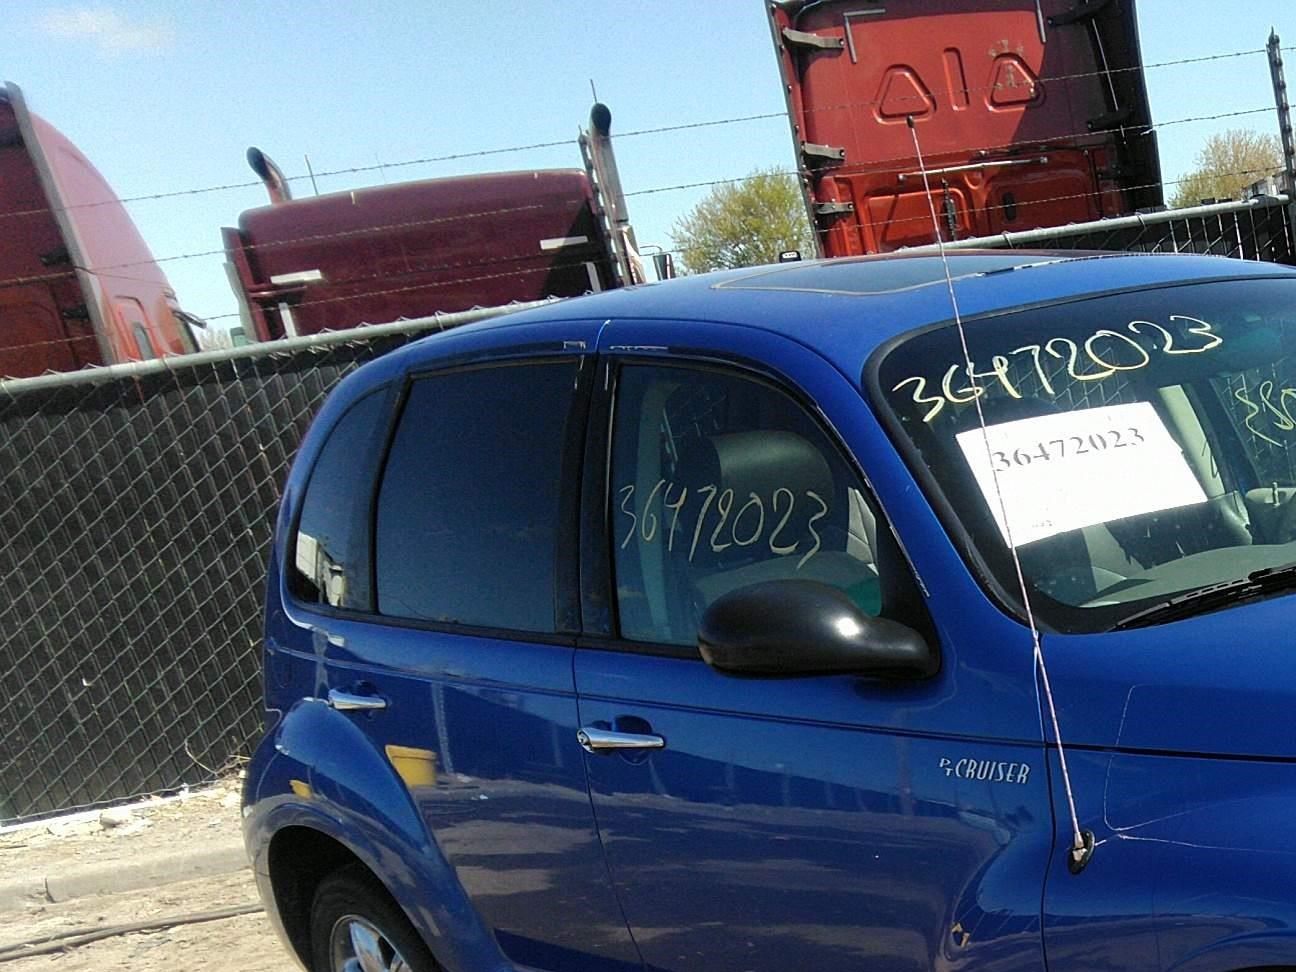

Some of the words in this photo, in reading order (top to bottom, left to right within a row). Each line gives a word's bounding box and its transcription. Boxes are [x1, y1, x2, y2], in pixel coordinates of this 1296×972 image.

[892, 315, 1223, 423] 36472023
[992, 427, 1145, 472] 36472023
[619, 479, 829, 571] 36472023
[955, 758, 1031, 784] CRUISER
